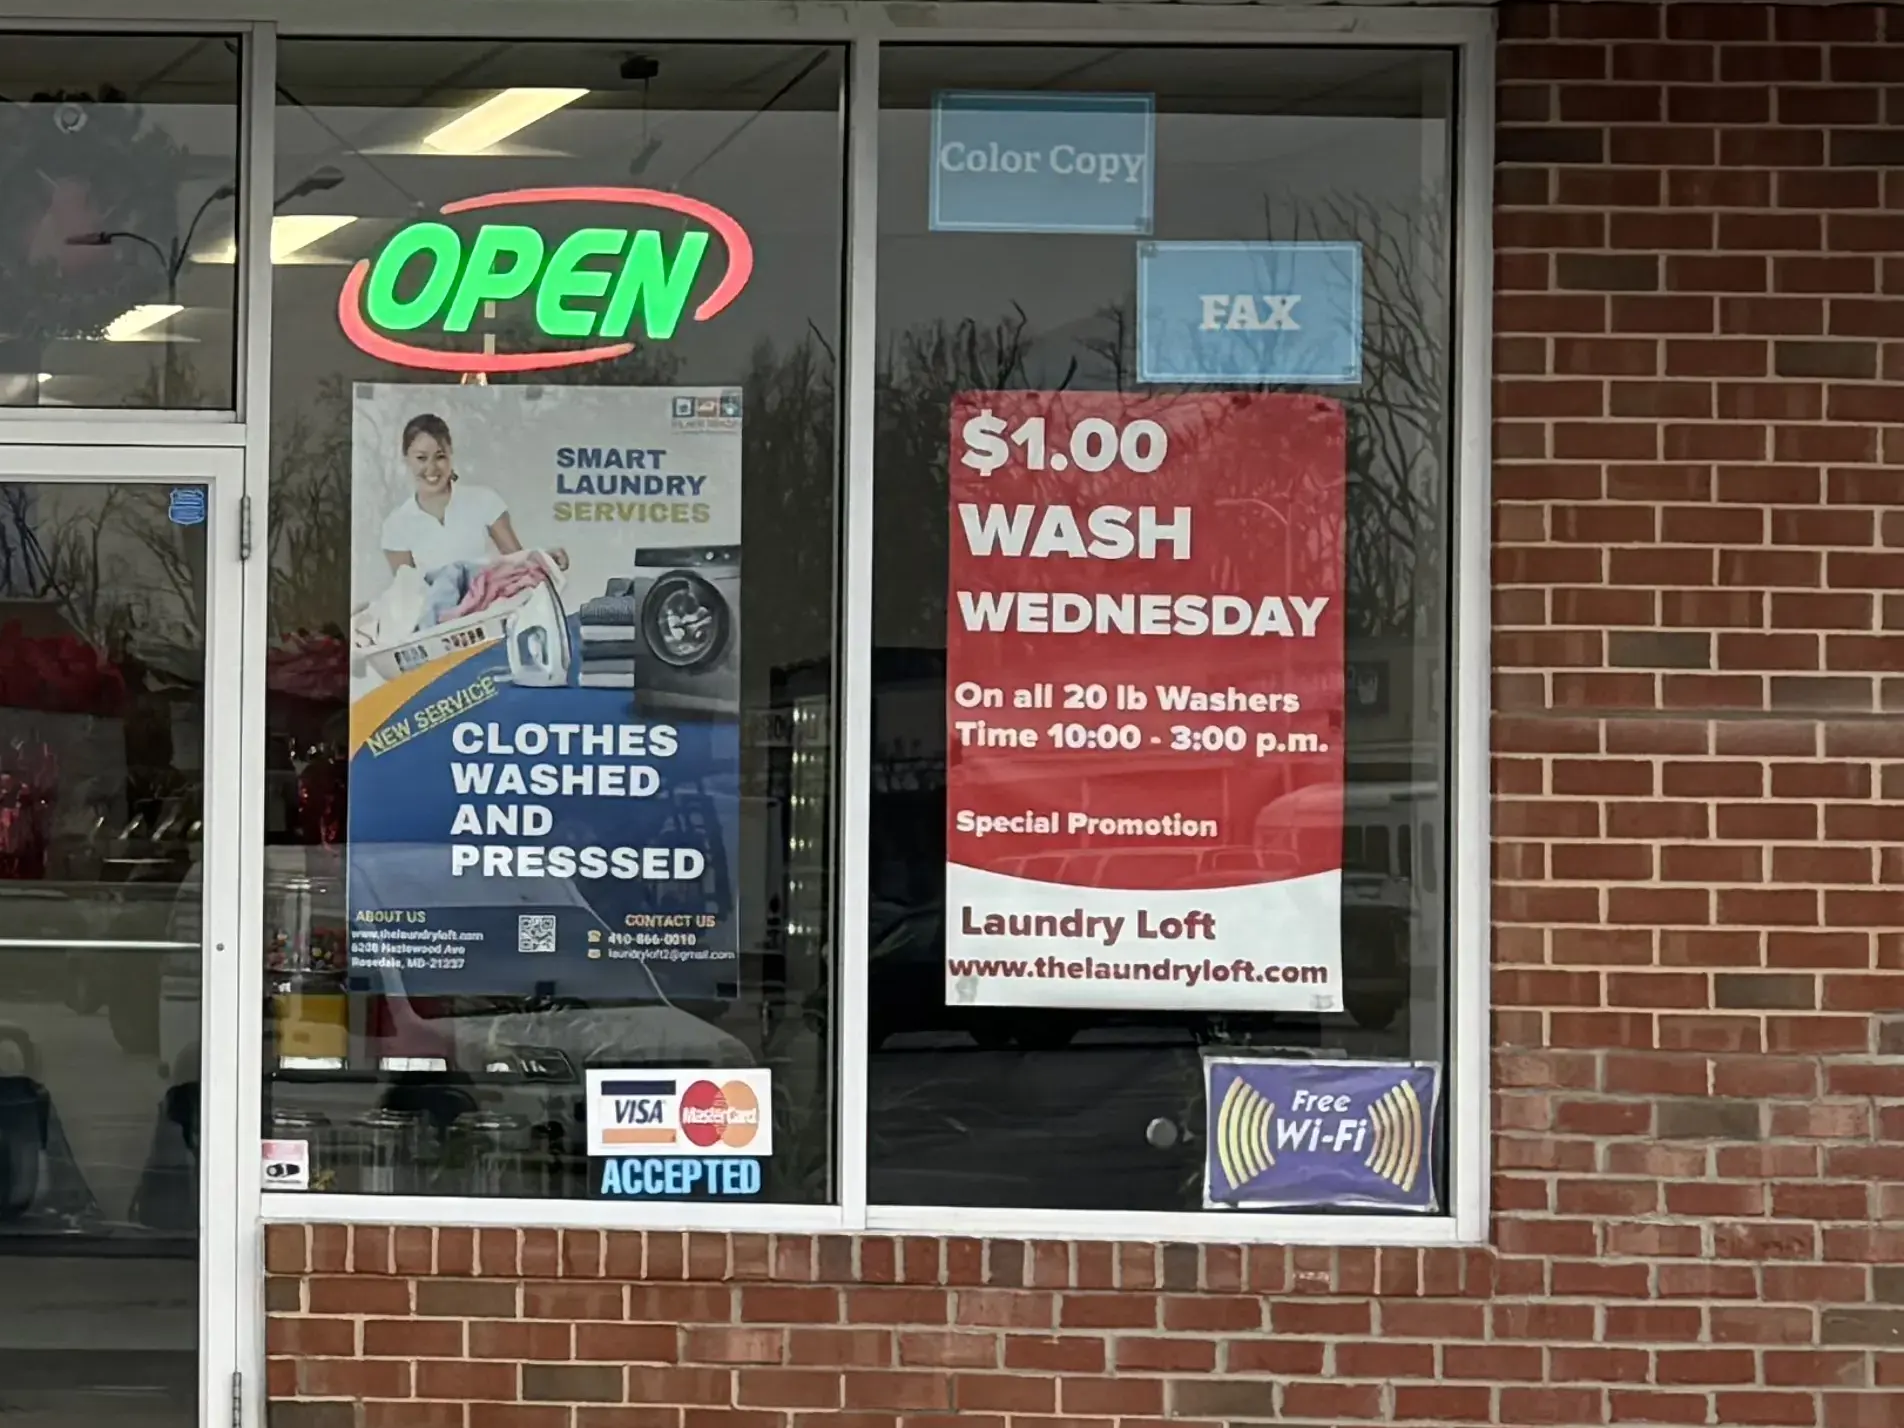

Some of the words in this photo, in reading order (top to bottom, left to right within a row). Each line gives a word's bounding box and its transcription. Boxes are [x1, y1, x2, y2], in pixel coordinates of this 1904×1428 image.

[940, 142, 1041, 172] Color
[1049, 145, 1146, 183] Copy
[367, 222, 709, 340] OPEN
[1198, 294, 1302, 331] FAX
[556, 448, 666, 470] SMART
[961, 408, 1168, 477] $1.00
[556, 475, 707, 496] LAUNDRY
[553, 502, 710, 524] SERVICES
[957, 503, 1192, 560] WASH
[957, 591, 1330, 637] WEDNESDAY
[954, 681, 1003, 709] On
[1013, 682, 1053, 709] all
[1063, 683, 1108, 710] 20
[1116, 683, 1148, 710] lb
[1156, 685, 1300, 713] Washers
[366, 717, 411, 756] NEW
[413, 676, 496, 730] SERVICE
[452, 722, 679, 757] CLOTHES
[954, 720, 1038, 748] Time
[1047, 723, 1142, 750] 10:00
[1170, 725, 1247, 751] 3:00
[1256, 729, 1329, 757] p.m.
[450, 762, 661, 797] WASHED
[450, 804, 554, 837] AND
[956, 810, 1059, 838] Special
[1067, 810, 1218, 837] Promotion
[452, 844, 705, 880] PRESSSED
[356, 910, 404, 923] ABOUT
[406, 911, 427, 923] US
[625, 914, 693, 927] CONTACT
[696, 915, 716, 927] US
[961, 906, 1124, 946] Laundry
[1137, 909, 1216, 940] Loft
[948, 956, 1328, 987] www.thelaundryloft.com
[613, 1099, 664, 1125] VISA
[682, 1106, 758, 1125] MasterCard
[1292, 1089, 1352, 1115] Free
[1276, 1118, 1367, 1153] Wi-Fi
[600, 1158, 760, 1195] ACCEPTED
